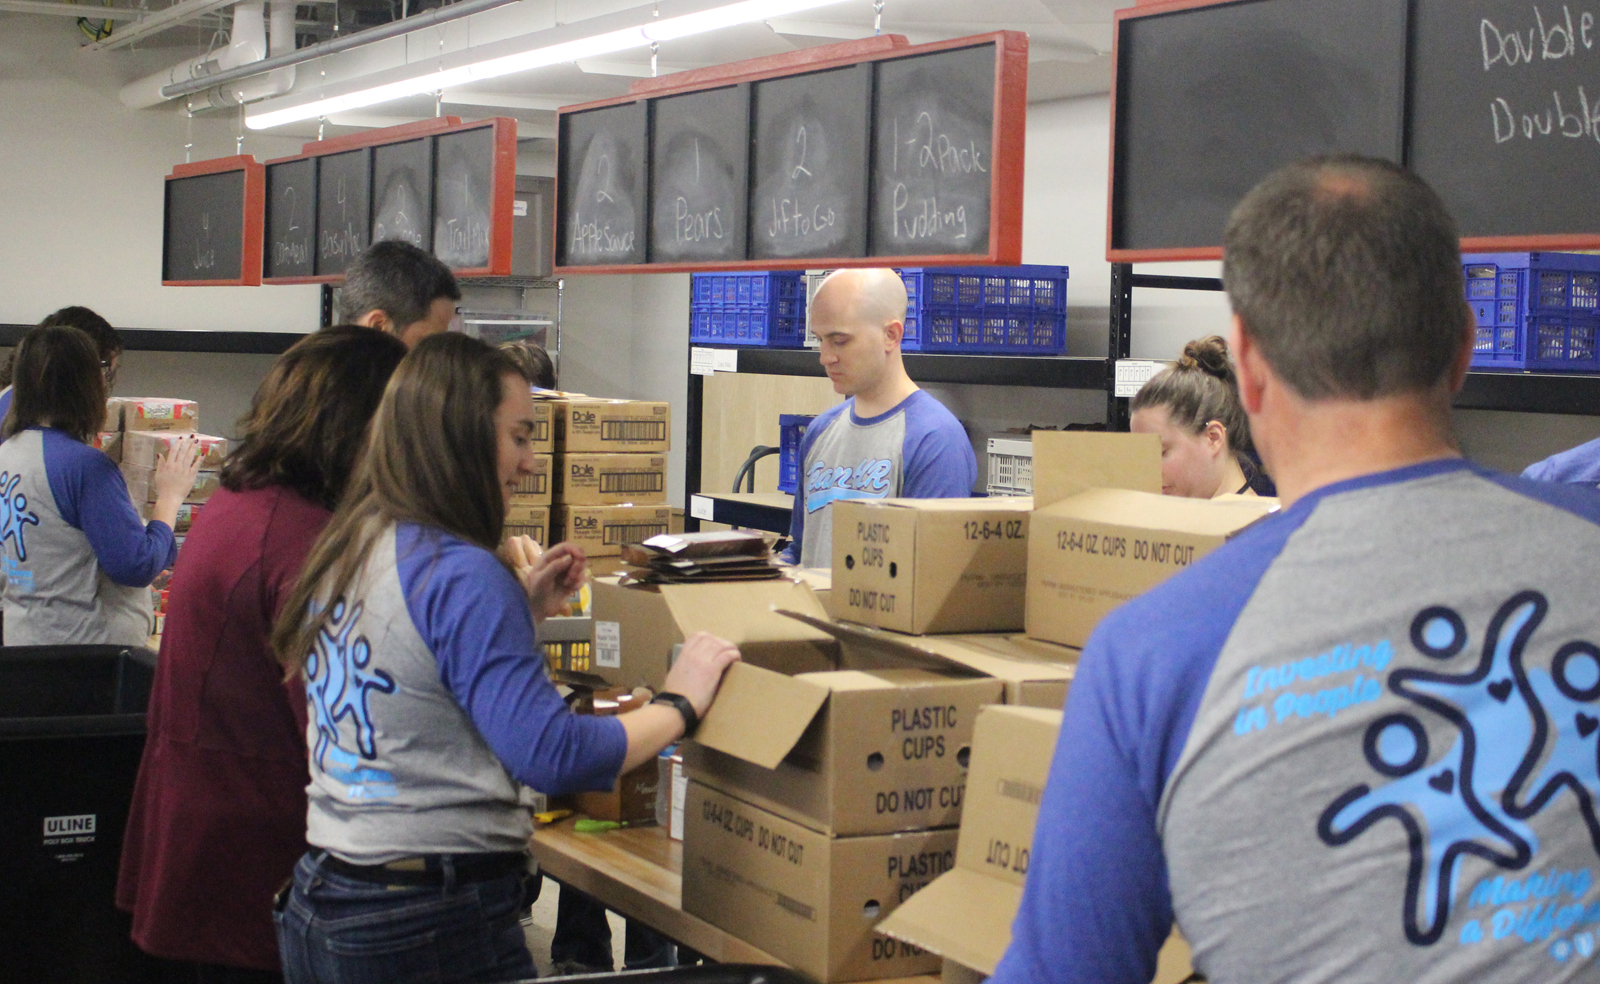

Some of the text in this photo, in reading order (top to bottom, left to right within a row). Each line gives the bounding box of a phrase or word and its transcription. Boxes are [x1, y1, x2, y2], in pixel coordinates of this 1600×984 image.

[1480, 5, 1594, 71] Double
[792, 126, 812, 179] 2
[597, 154, 614, 203] 2
[284, 186, 299, 231] 2
[676, 196, 723, 245] Pears
[893, 182, 967, 239] Pudding
[573, 410, 595, 422] Dole
[571, 464, 594, 476] Dole
[574, 515, 598, 528] Dole
[857, 521, 890, 544] PLASTIC
[964, 521, 1002, 540] 12-6-4
[862, 547, 884, 567] CUPS
[1057, 531, 1084, 552] 12-6-4
[1102, 536, 1126, 558] CUPS
[1134, 540, 1148, 560] DO
[1151, 542, 1171, 563] NOT
[1174, 545, 1195, 566] CUT
[849, 588, 896, 613] DO NOT CUT
[891, 705, 957, 732] PLASTIC
[903, 735, 946, 760] CUPS
[876, 791, 899, 814] DO
[904, 787, 935, 812] NOT
[47, 818, 93, 832] ULINE
[887, 850, 953, 878] PLASTIC
[1013, 846, 1029, 874] OT
[873, 938, 896, 960] DO
